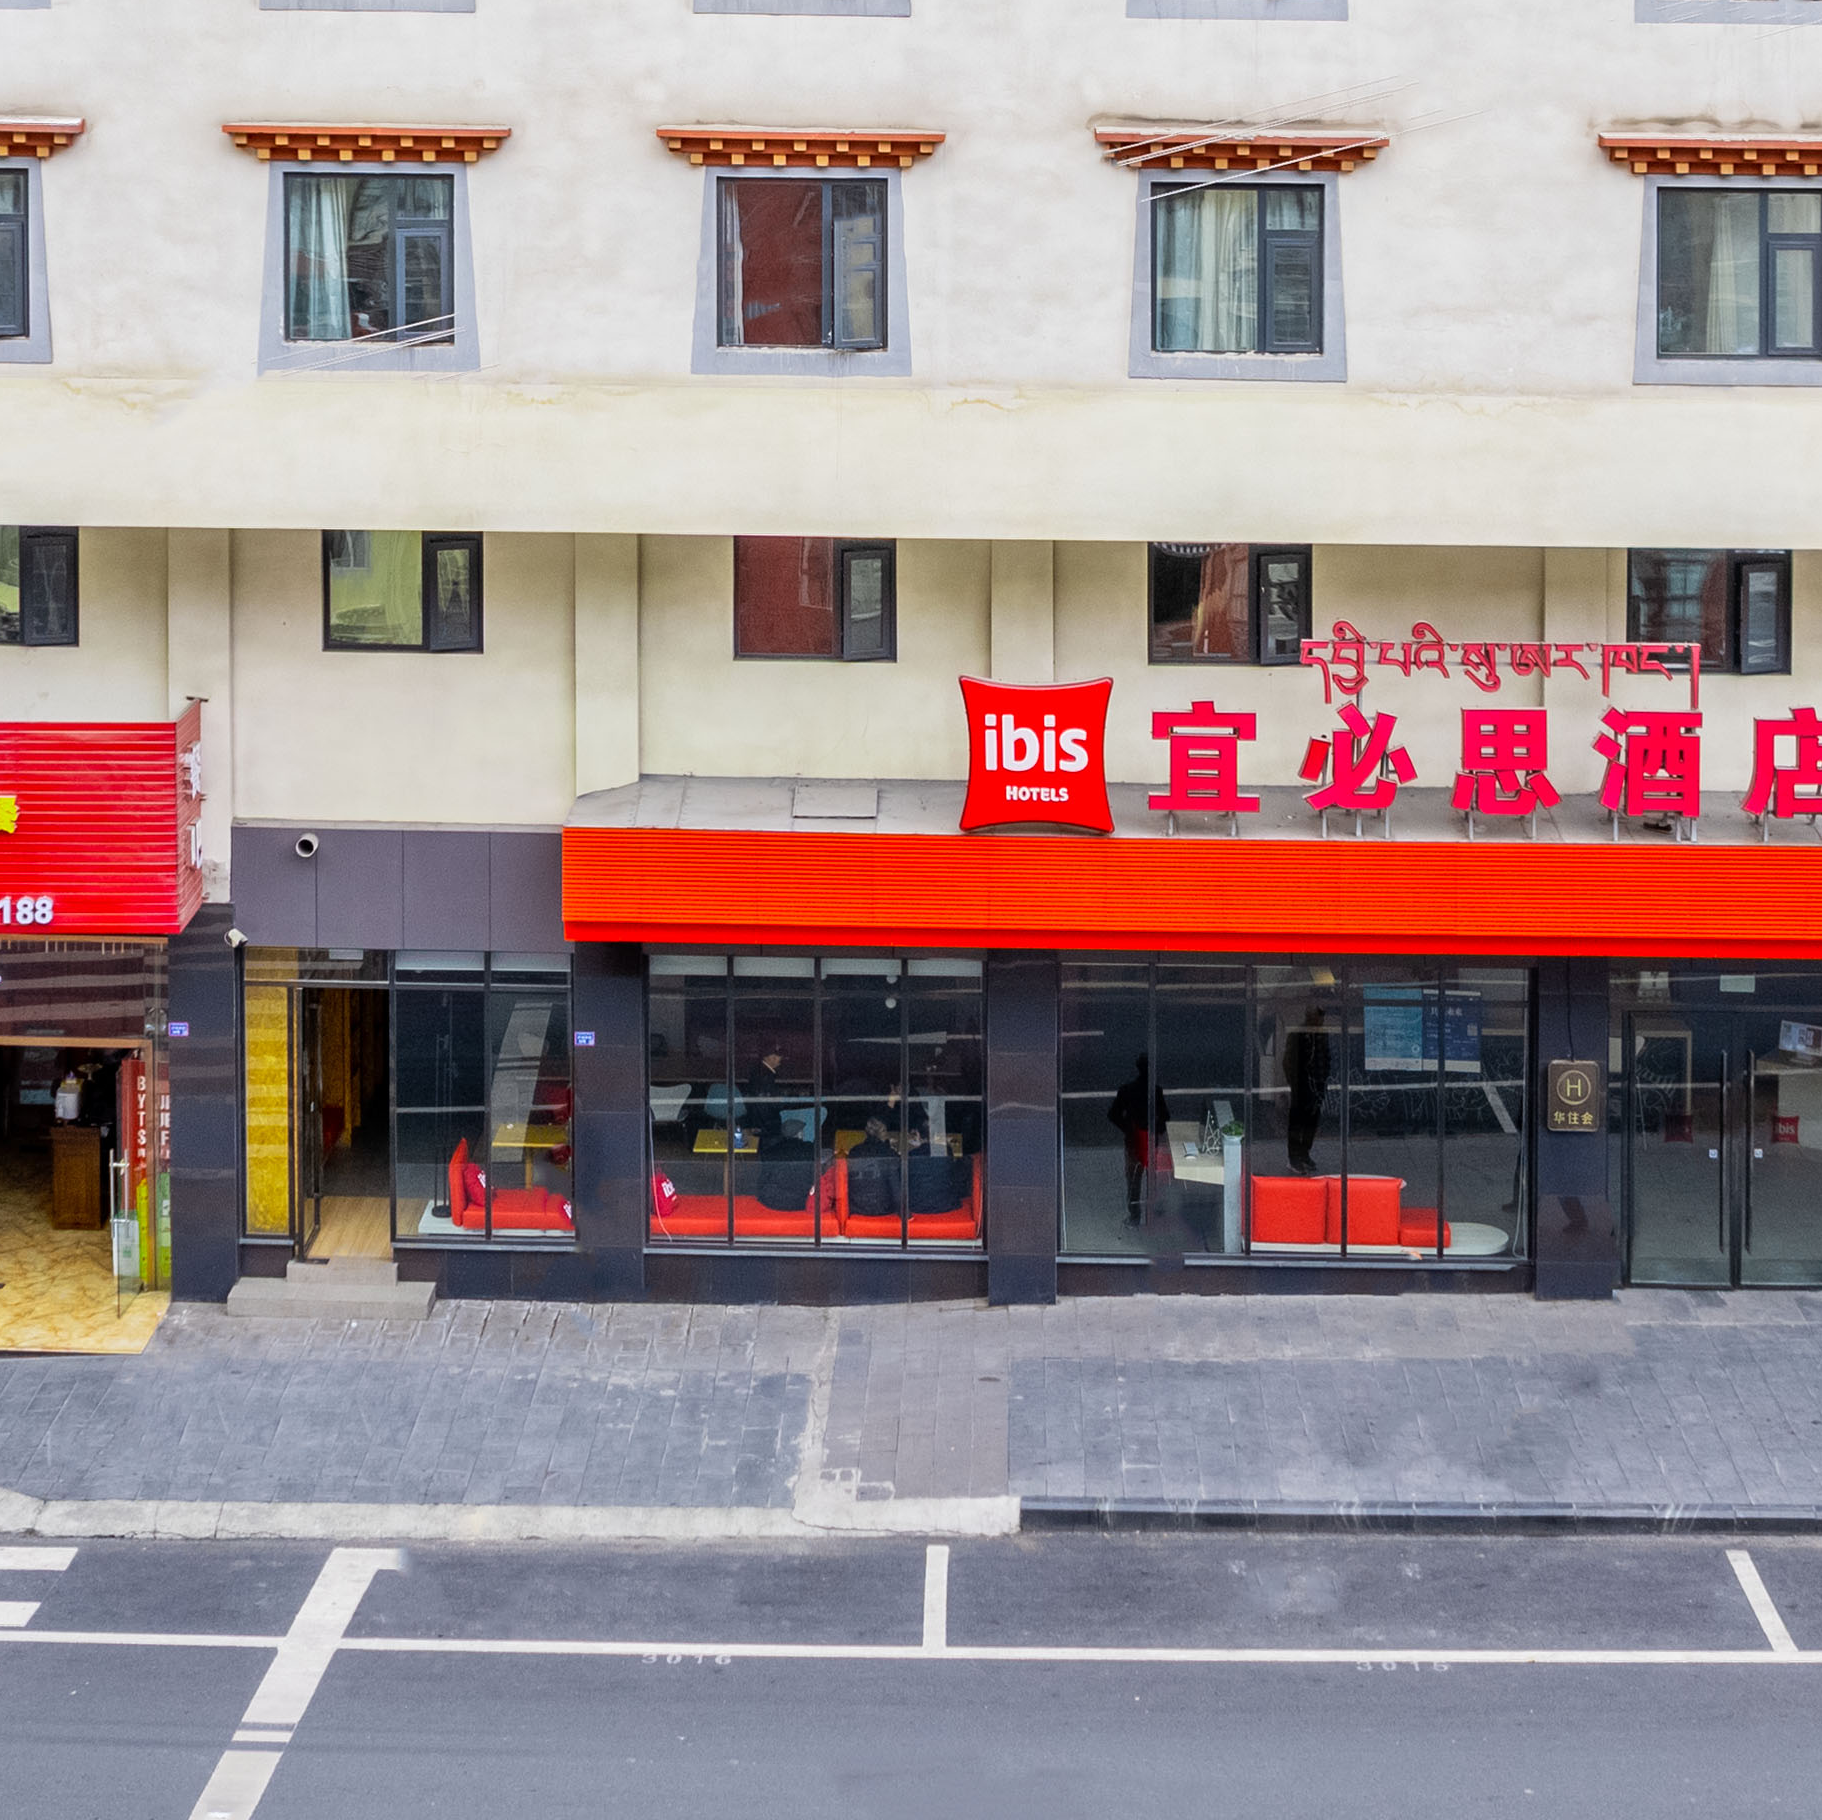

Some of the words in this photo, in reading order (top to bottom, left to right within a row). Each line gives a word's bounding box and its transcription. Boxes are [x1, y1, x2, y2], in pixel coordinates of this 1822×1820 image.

[984, 713, 1089, 773] ibis
[1005, 785, 1069, 802] HOTELS
[1553, 1110, 1594, 1125] 华住会
